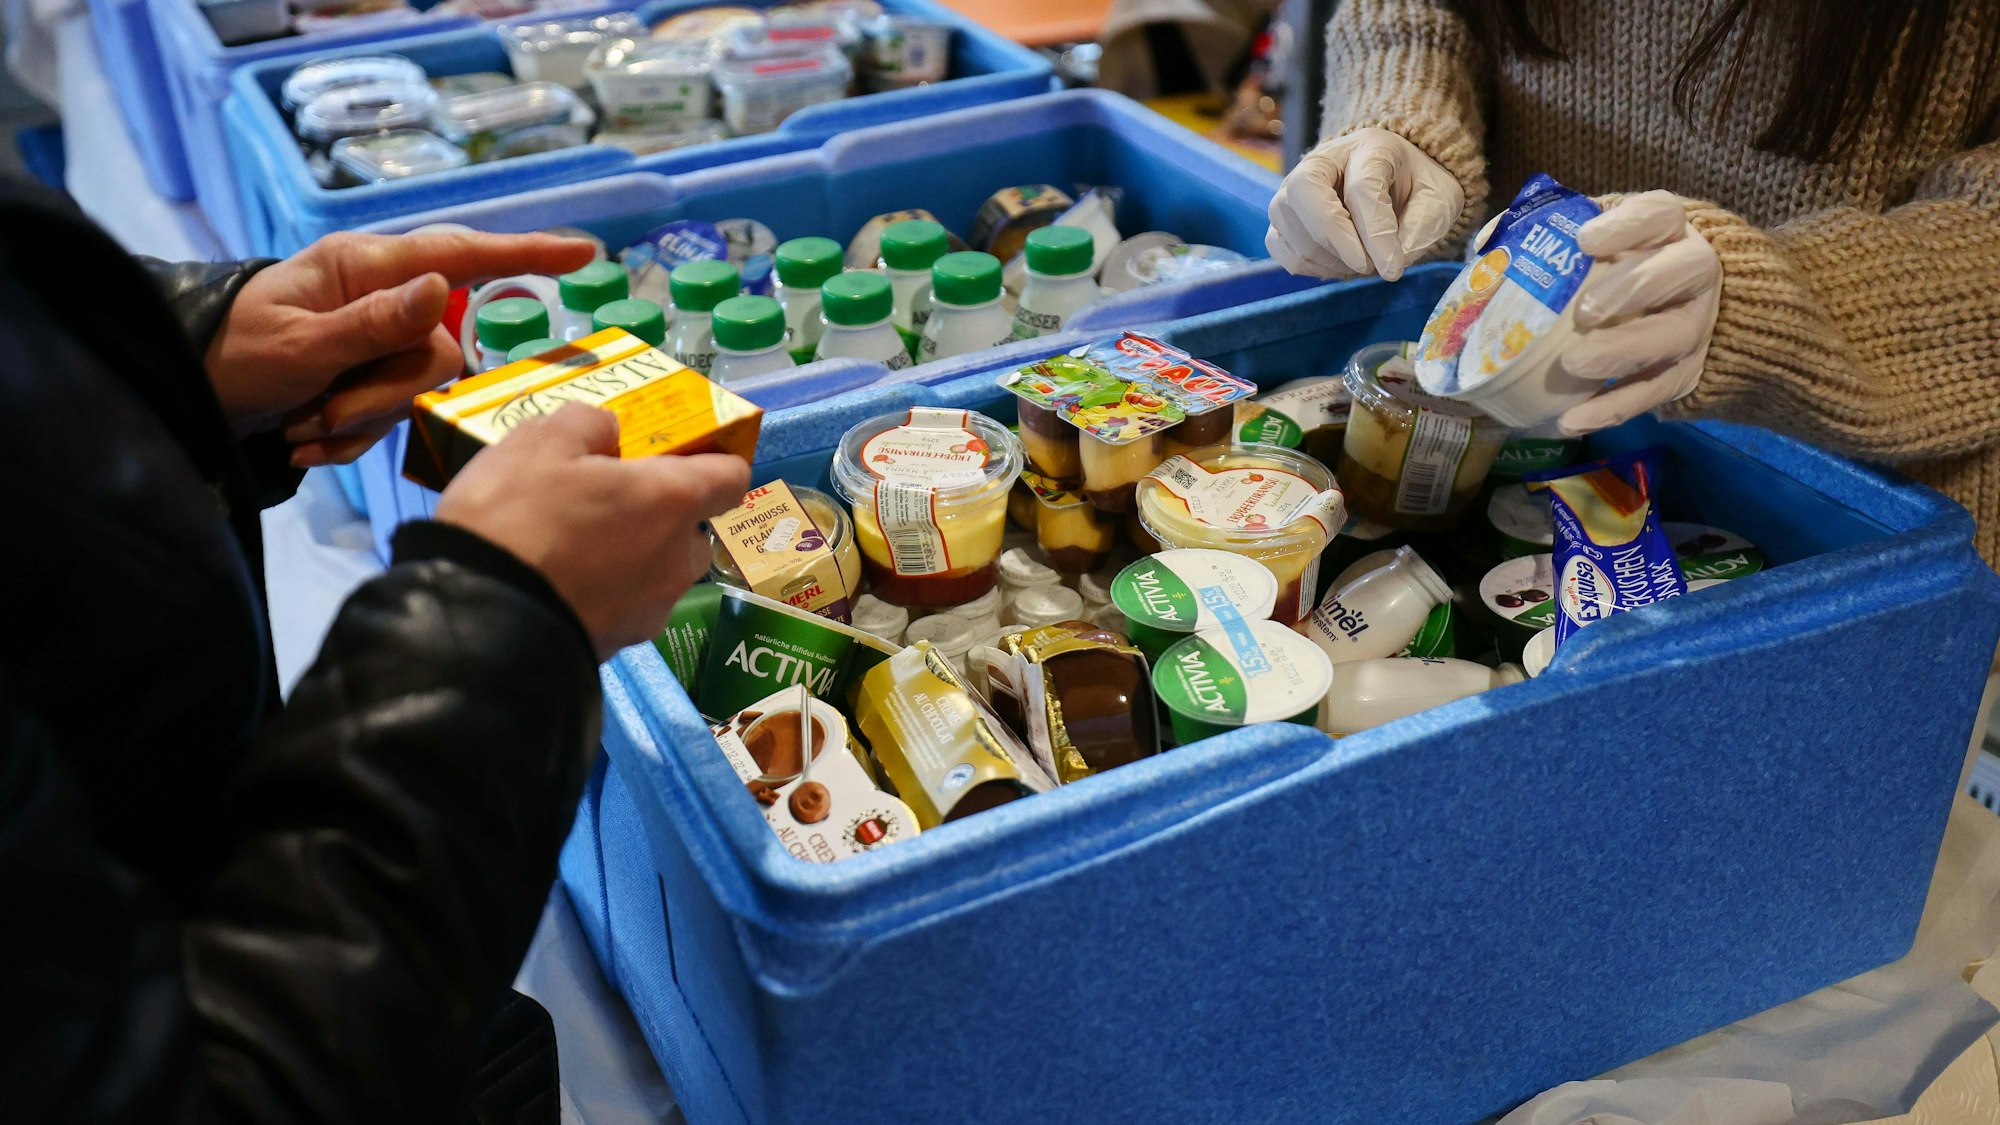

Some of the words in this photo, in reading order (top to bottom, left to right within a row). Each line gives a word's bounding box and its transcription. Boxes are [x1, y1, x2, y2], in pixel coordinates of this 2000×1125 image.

[1520, 224, 1583, 275] ELINAS
[727, 502, 790, 537] ZIMTMOUSSE
[1133, 569, 1183, 622] ACTIVIA
[754, 632, 790, 650] natürliche
[791, 644, 815, 658] Bifidus
[1180, 650, 1232, 714] ACTIVIA
